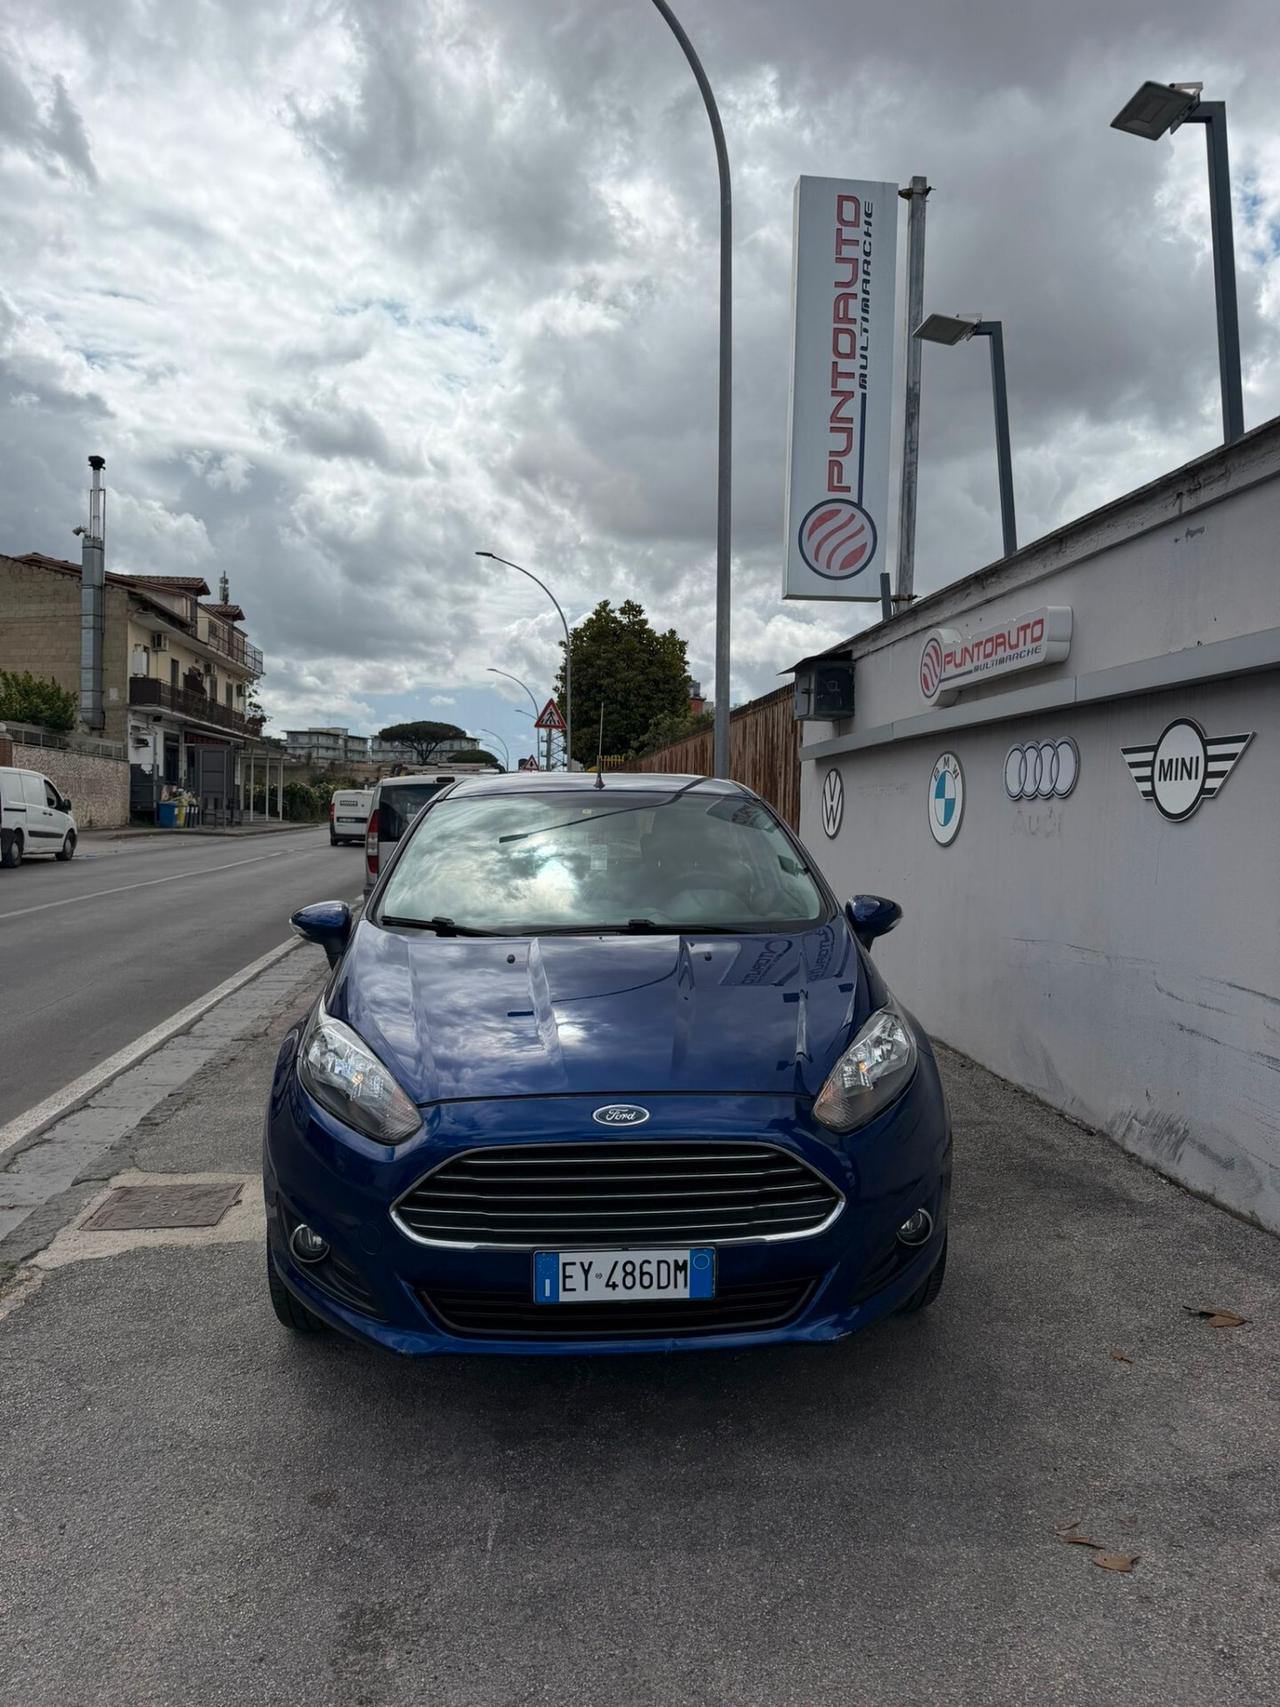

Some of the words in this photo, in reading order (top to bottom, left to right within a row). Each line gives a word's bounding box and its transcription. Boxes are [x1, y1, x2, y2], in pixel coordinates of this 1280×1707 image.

[858, 200, 874, 391] MULTIMARCHE
[827, 194, 862, 494] PUNTOAUTO
[943, 618, 1045, 673] PUNTOAUTO
[973, 645, 1043, 673] MULTIMARCHE
[933, 756, 960, 782] BMW
[1158, 755, 1200, 783] MINI
[605, 1107, 636, 1122] Ford
[562, 1261, 593, 1293] EY
[605, 1259, 689, 1291] 486DM
